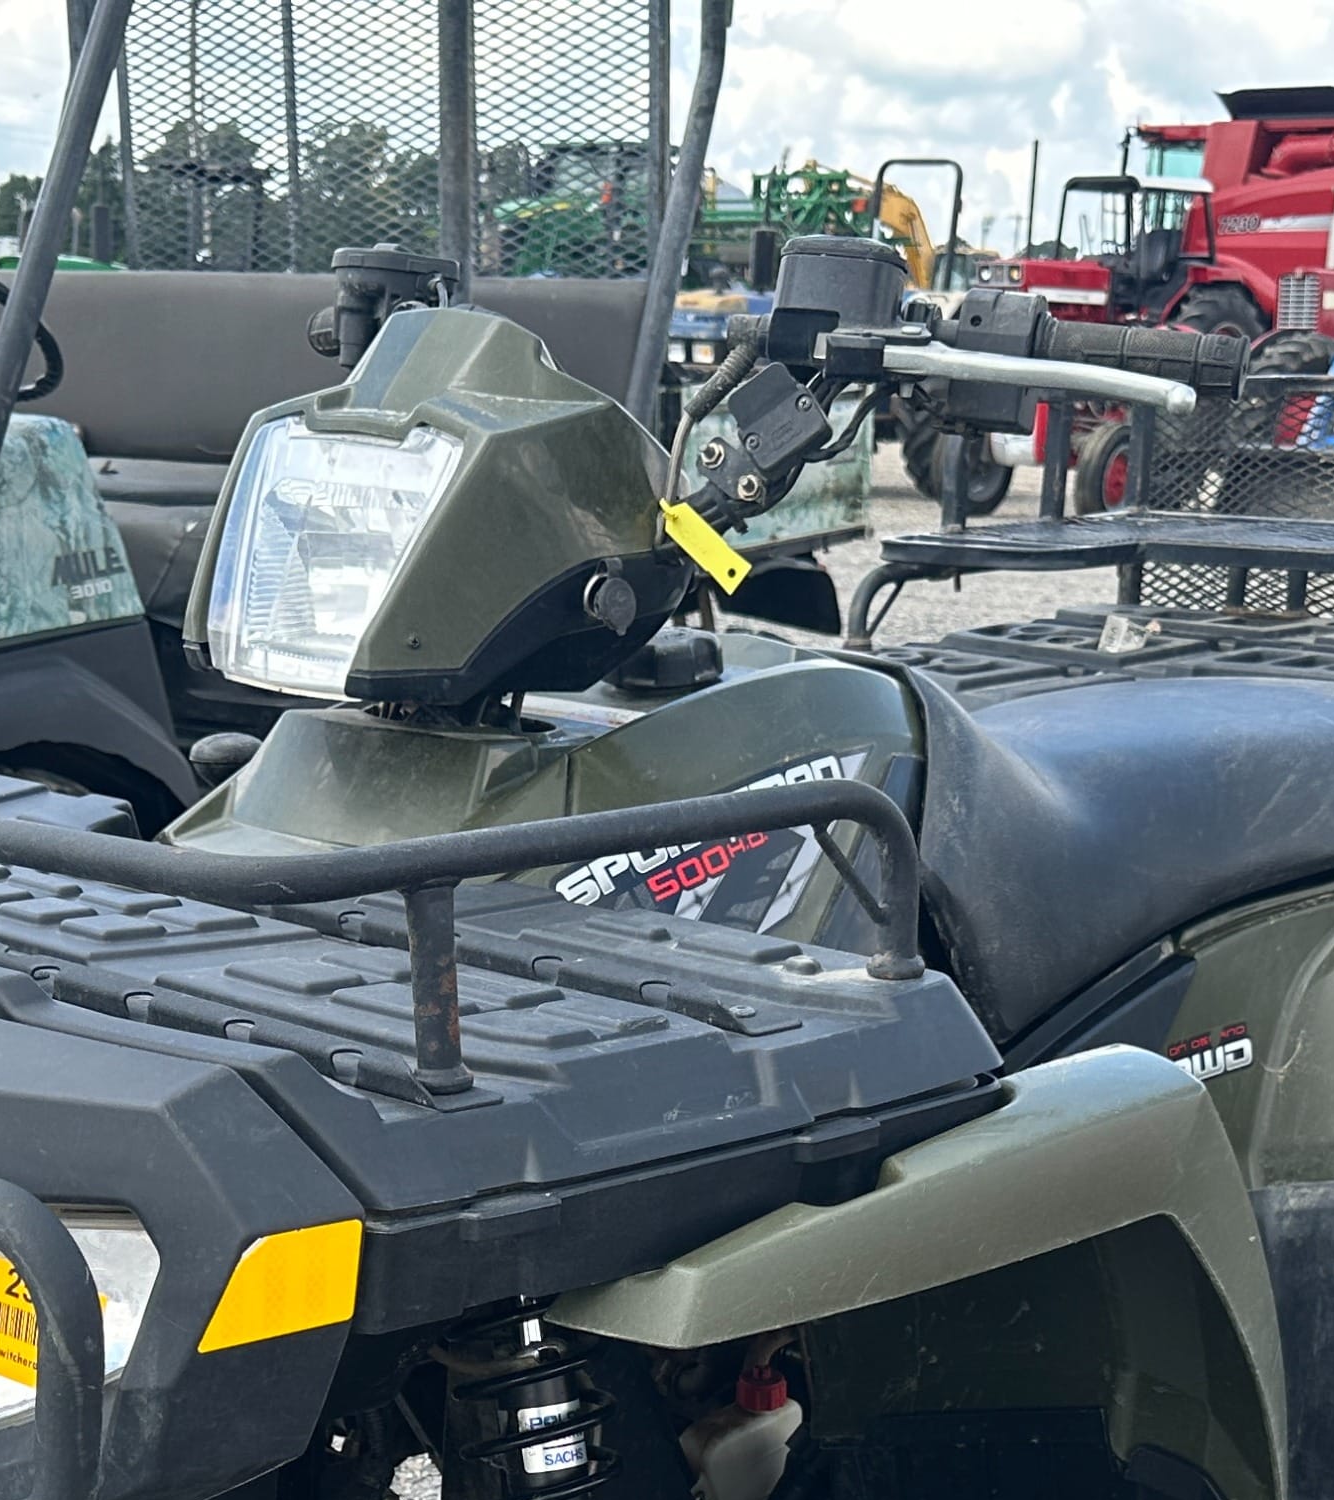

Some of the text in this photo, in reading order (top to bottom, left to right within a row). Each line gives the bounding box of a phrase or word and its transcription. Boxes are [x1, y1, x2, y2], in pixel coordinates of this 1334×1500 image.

[50, 546, 126, 587] MULE
[70, 579, 113, 600] 3010
[647, 845, 730, 902] 500
[544, 1447, 584, 1466] SACHS
